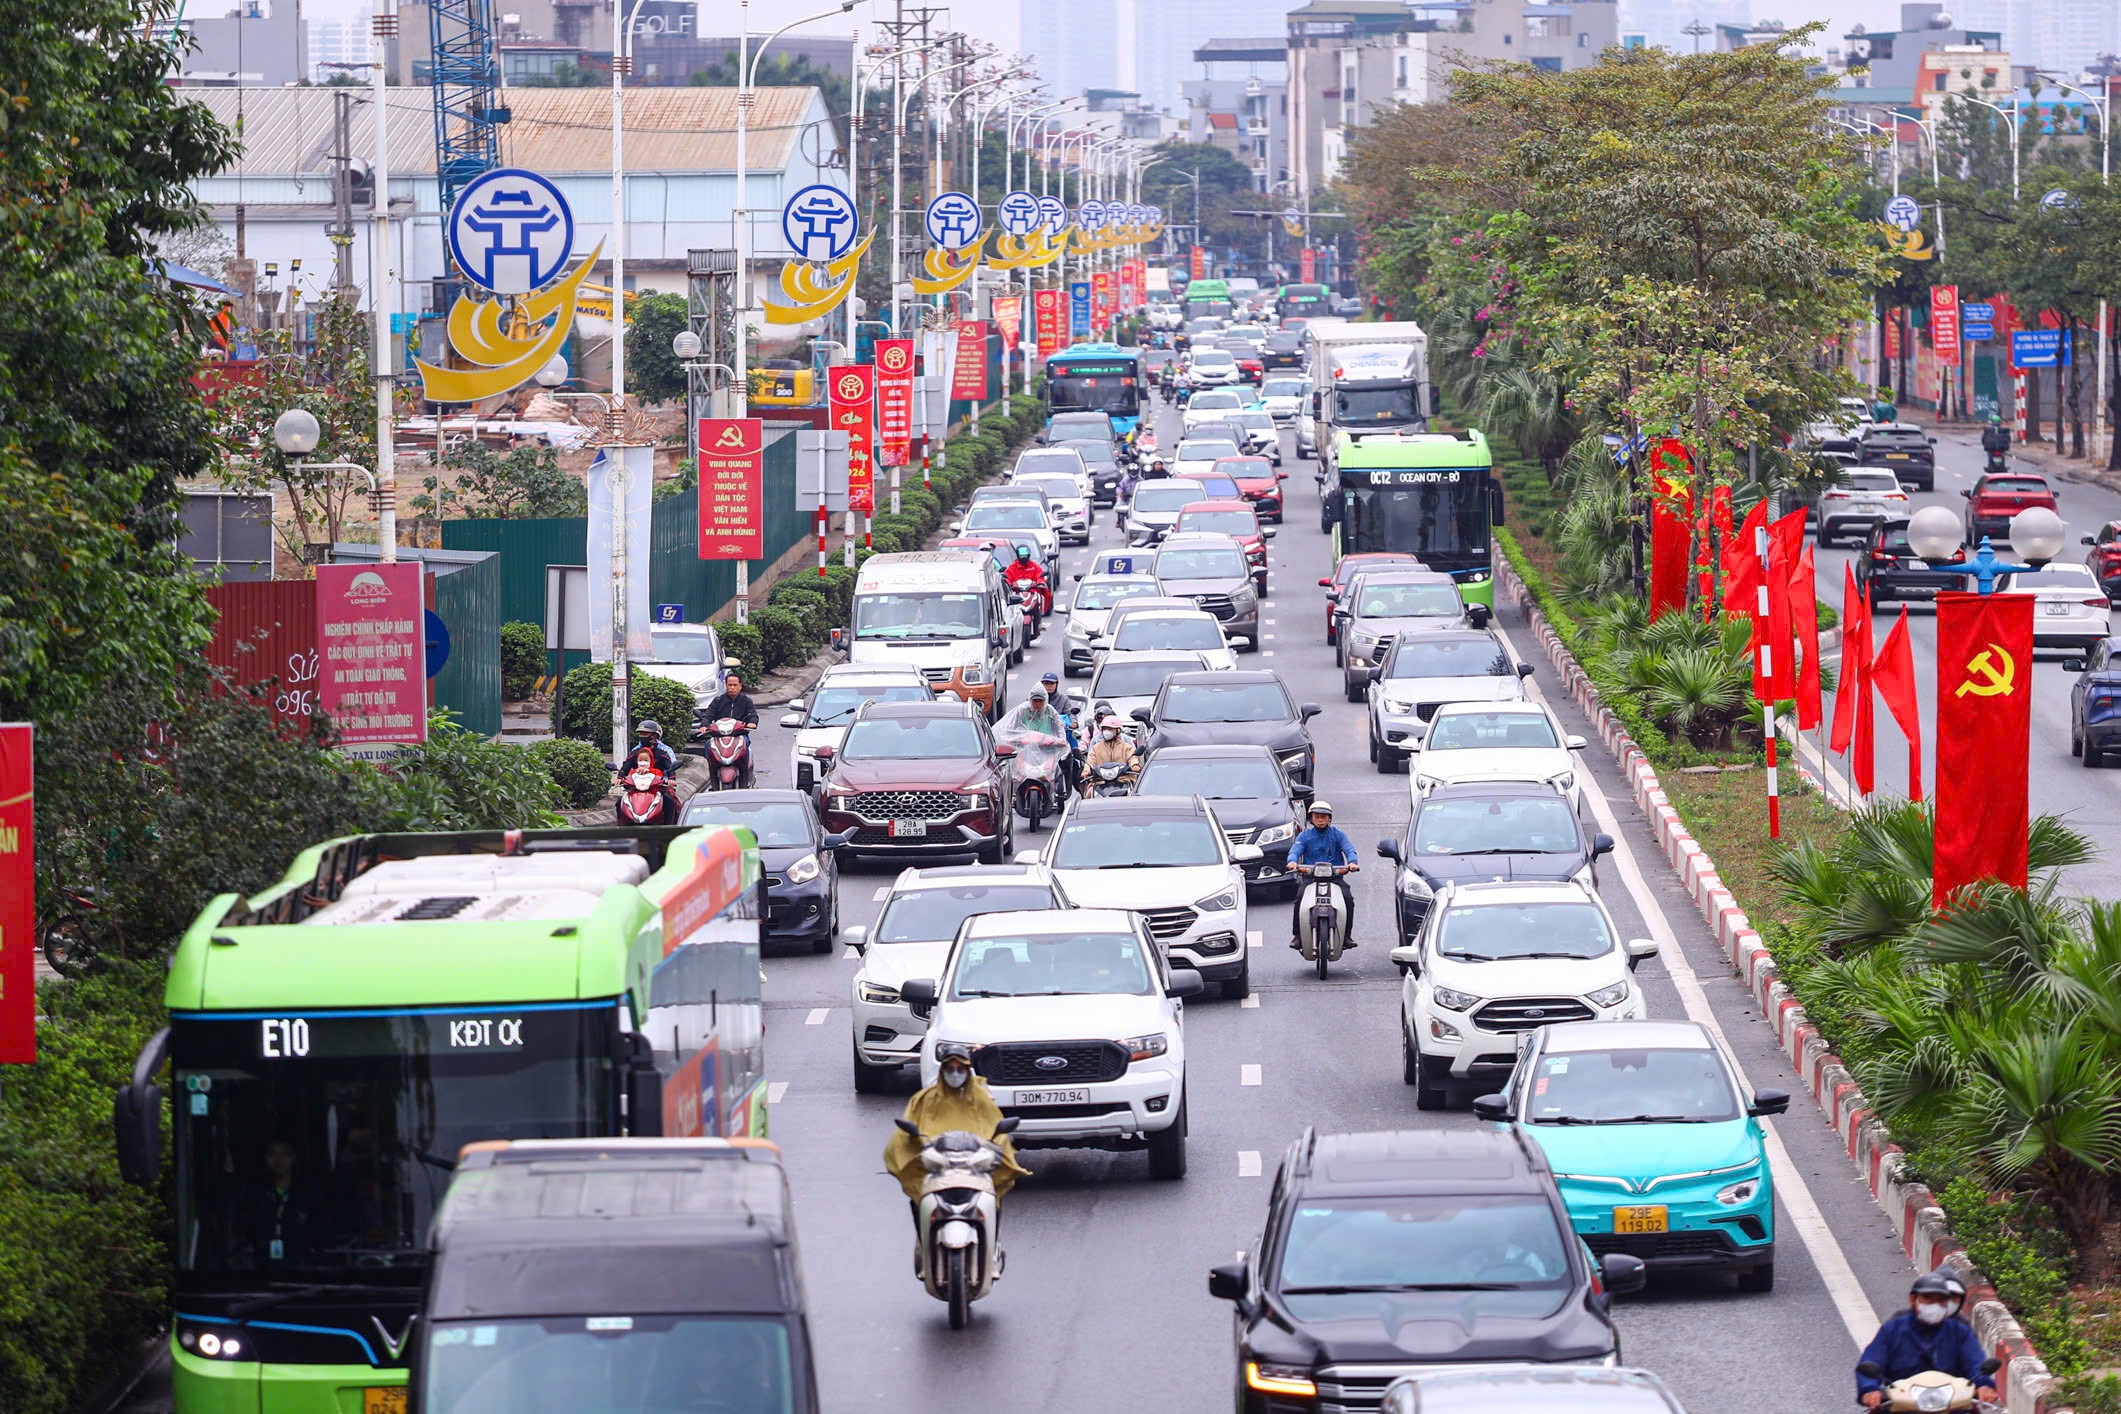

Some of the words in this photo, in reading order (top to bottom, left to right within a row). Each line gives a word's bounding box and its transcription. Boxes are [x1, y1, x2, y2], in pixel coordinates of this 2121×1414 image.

[709, 460, 726, 468] VINH
[728, 460, 752, 469] QUANG
[1370, 471, 1392, 485] OCT2
[1400, 472, 1425, 483] OCEAN
[1426, 472, 1442, 483] CITY
[714, 482, 736, 492] THUỘC
[738, 482, 747, 490] VỀ
[715, 493, 731, 502] DÂN
[732, 493, 746, 503] TỘC
[713, 504, 728, 514] VIỆT
[730, 505, 748, 513] NAM
[714, 515, 729, 524] VĂN
[730, 515, 748, 524] HIẾN
[705, 526, 715, 536] VÀ
[716, 528, 732, 536] ANH
[733, 527, 756, 536] HÙNG!
[1112, 559, 1127, 572] G7
[661, 606, 678, 621] G7
[324, 620, 352, 636] NGHIÊM
[352, 617, 374, 636] CHỈNH
[375, 616, 393, 634] CHẤP
[394, 618, 414, 633] HÀNH
[327, 644, 341, 660] CÁC
[343, 646, 356, 660] QUY
[358, 646, 375, 662] ĐỊNH
[375, 643, 384, 658] VỀ
[385, 643, 402, 660] TRẬT
[403, 642, 413, 660] TỰ
[334, 669, 345, 683] AN
[346, 667, 364, 683] TOÀN
[365, 668, 381, 682] GIAO
[382, 665, 407, 682] THÔNG,
[364, 690, 374, 708] TỰ
[374, 689, 383, 705] ĐÔ
[385, 691, 396, 707] THỊ
[351, 716, 368, 729] SINH
[369, 712, 382, 729] MÔI
[384, 711, 413, 728] TRƯỜNG!
[352, 751, 374, 760] TAXI
[375, 750, 399, 760] LONG
[903, 820, 917, 828] 28A
[262, 1018, 310, 1058] E10
[450, 1019, 493, 1047] KĐT
[1629, 1207, 1653, 1220] 29E
[1621, 1220, 1662, 1232] 119.02
